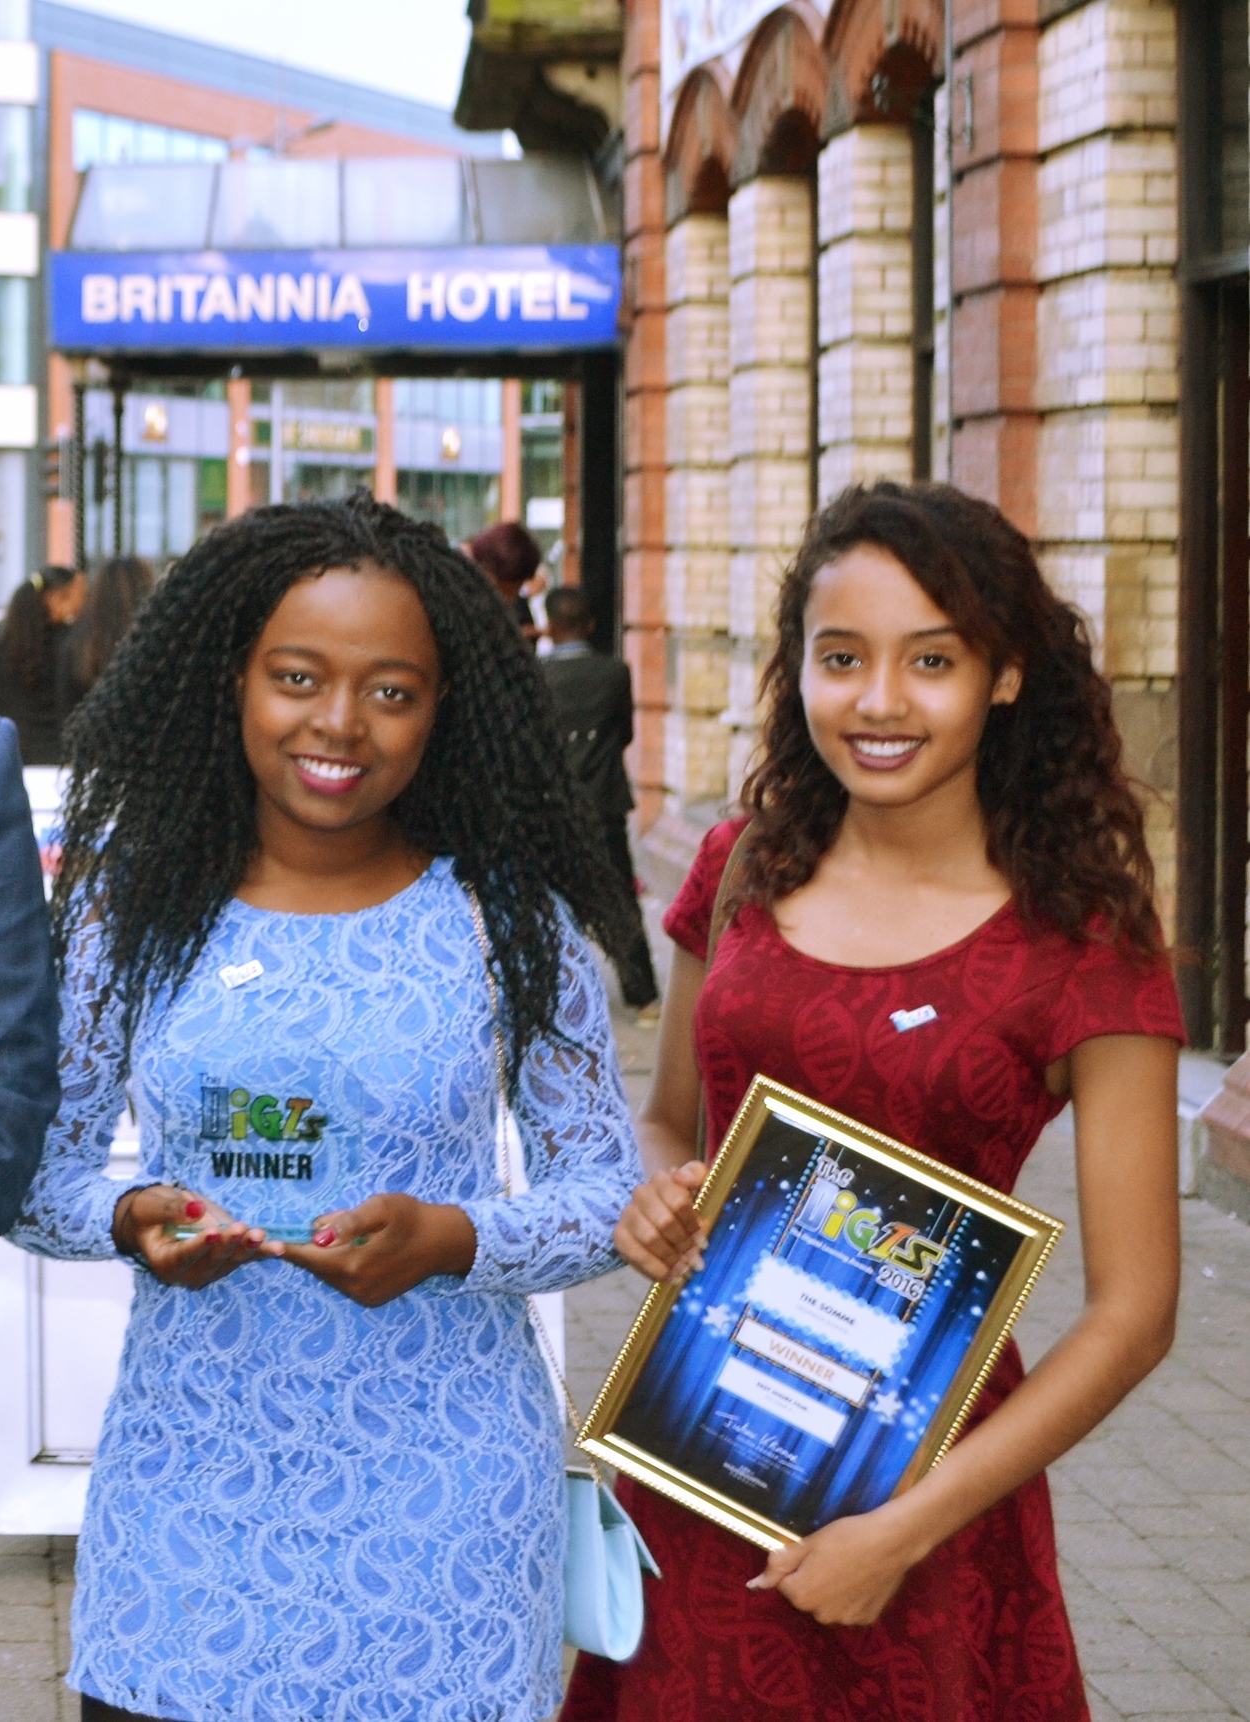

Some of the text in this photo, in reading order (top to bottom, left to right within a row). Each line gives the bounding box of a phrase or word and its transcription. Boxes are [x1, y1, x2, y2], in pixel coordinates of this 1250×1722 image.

[81, 271, 589, 323] BRITANNIA HOTEL
[211, 1151, 312, 1180] WINNER
[878, 1266, 924, 1299] 2016
[800, 1293, 817, 1307] THE
[819, 1303, 856, 1326] SOMME
[769, 1339, 836, 1381] WINNER
